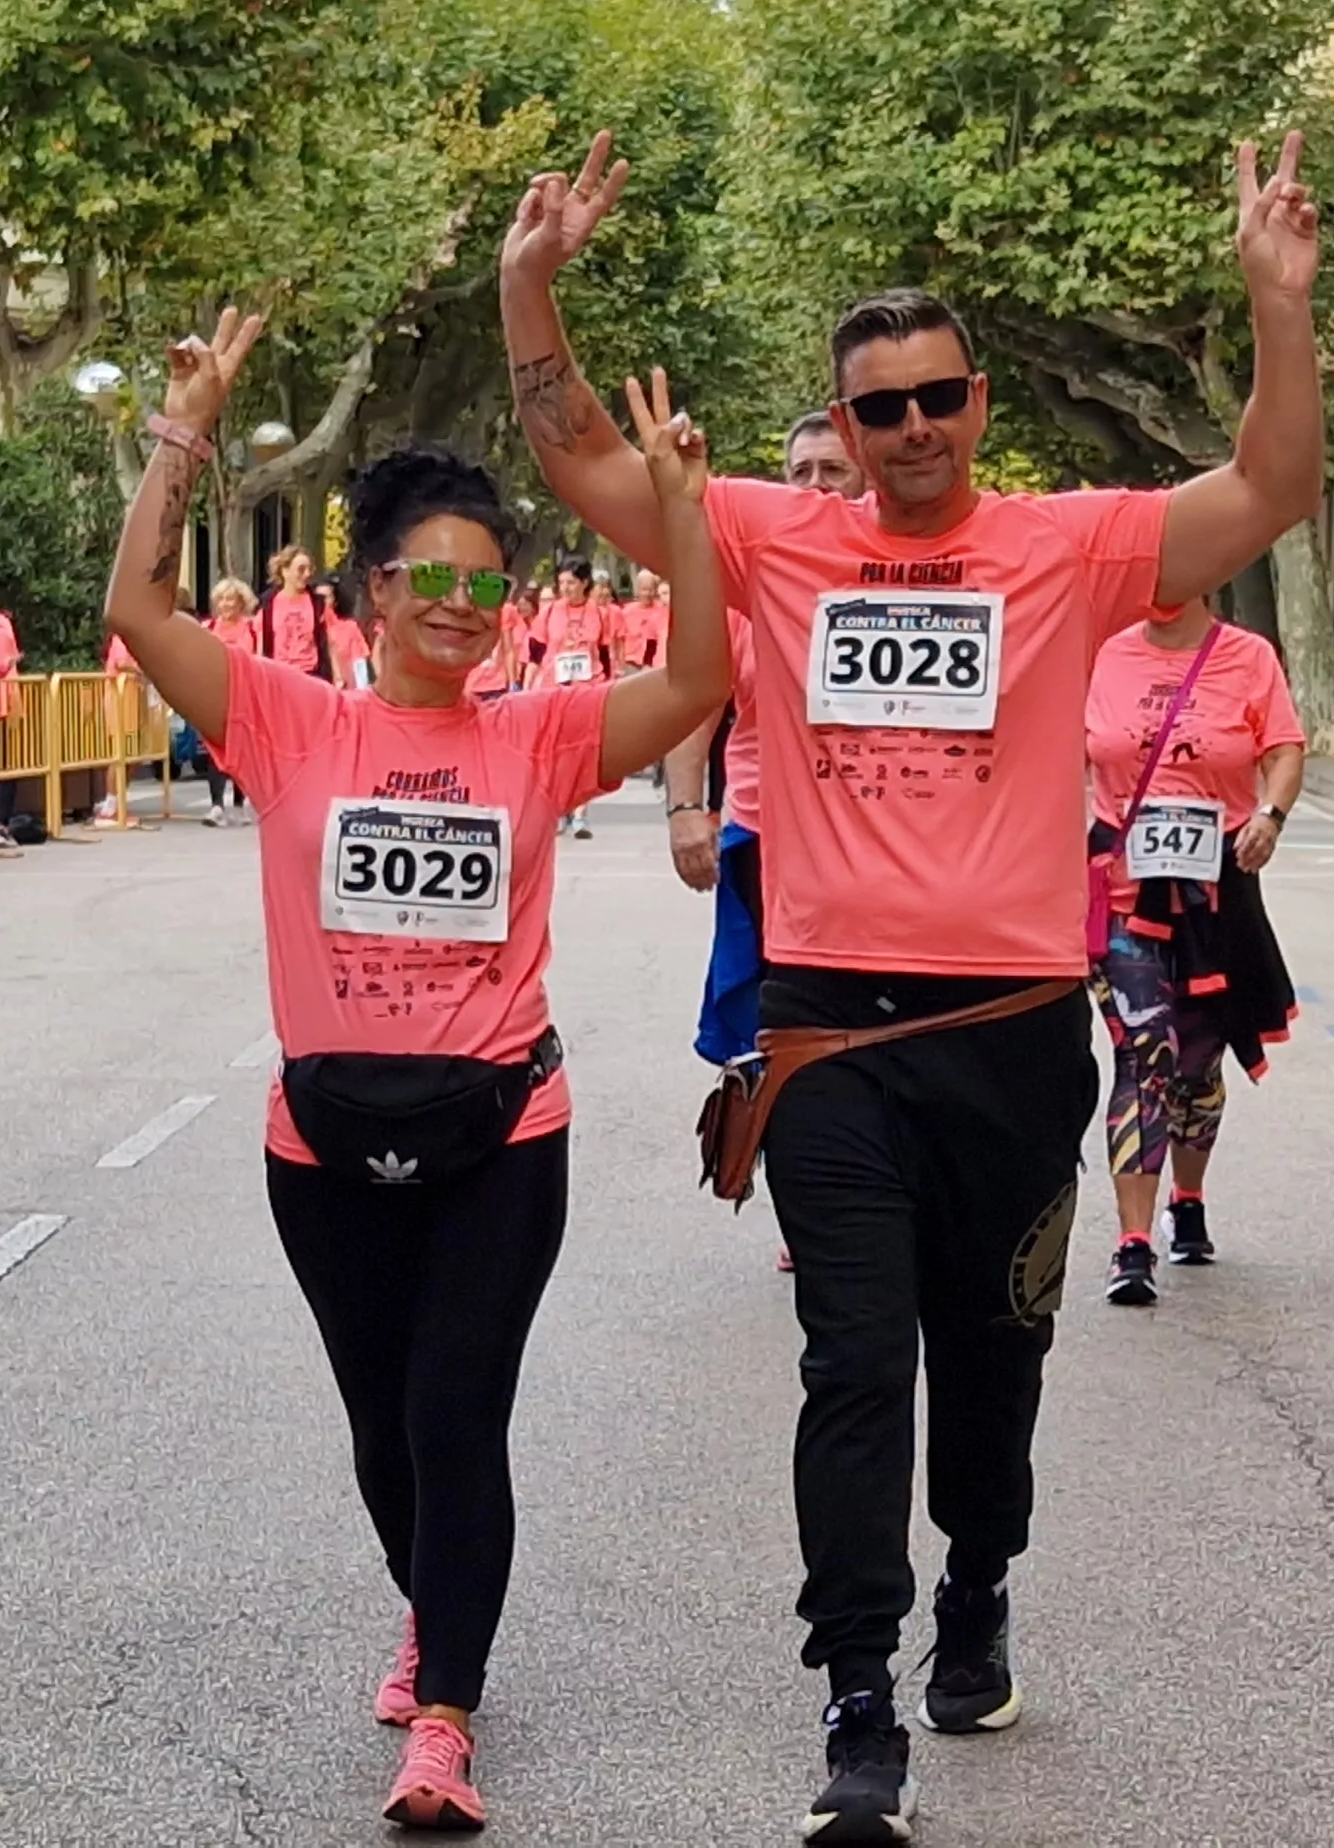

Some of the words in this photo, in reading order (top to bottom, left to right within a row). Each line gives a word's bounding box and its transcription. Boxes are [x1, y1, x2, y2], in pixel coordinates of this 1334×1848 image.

[836, 615, 897, 629] CONTRA
[901, 616, 918, 629] EL
[921, 613, 981, 631] CÁNCER
[830, 637, 980, 689] 3028
[349, 822, 412, 840] CONTRA
[415, 826, 431, 841] EL
[435, 827, 493, 844] CÁNCER
[1143, 826, 1204, 855] 547
[343, 844, 493, 900] 3029
